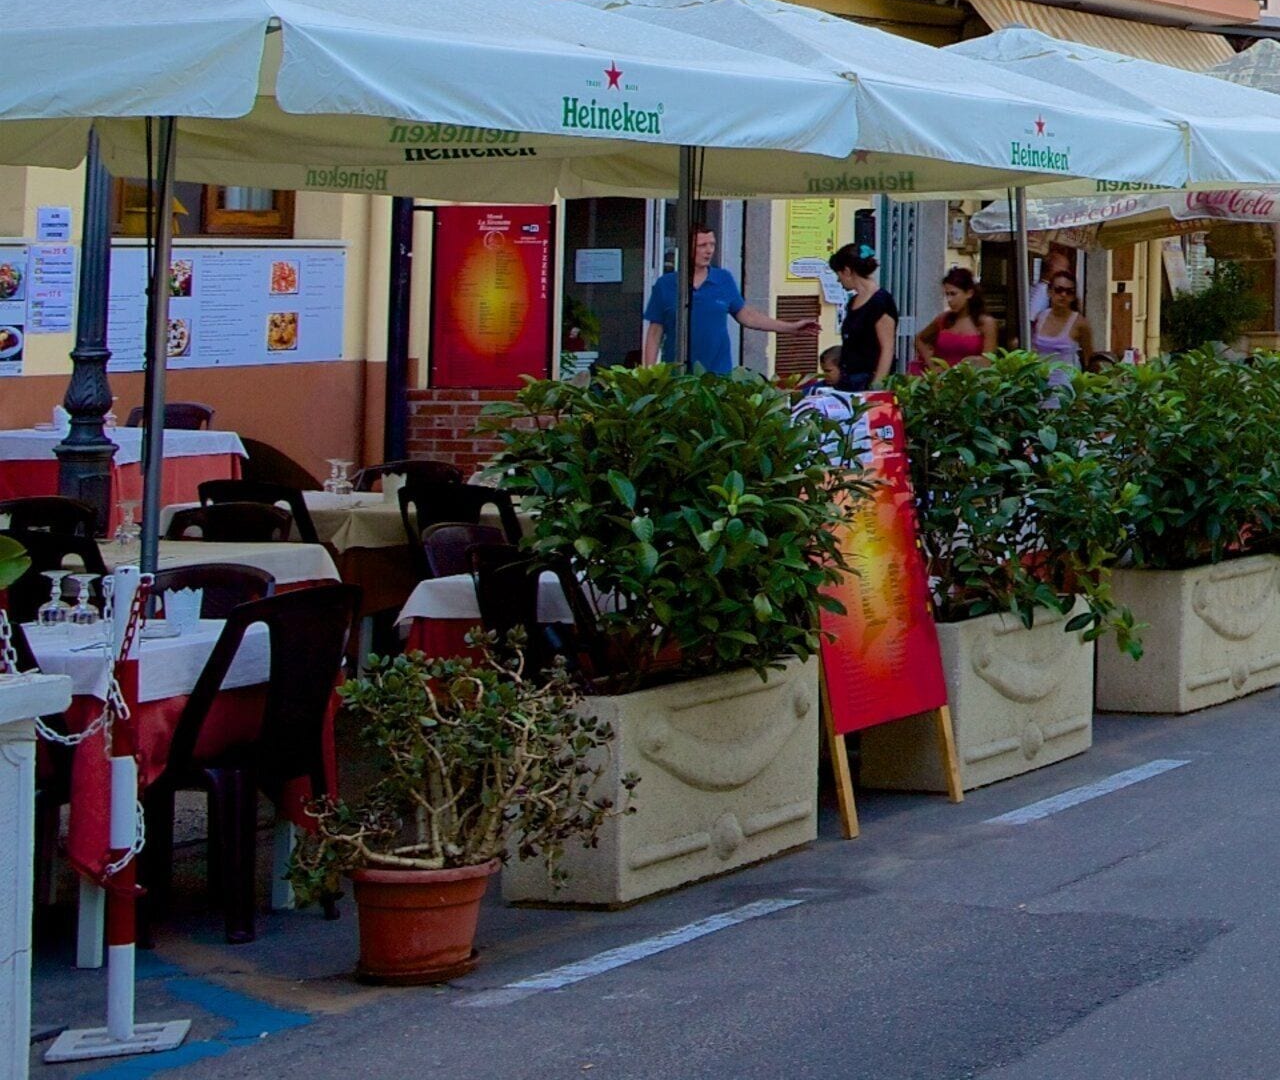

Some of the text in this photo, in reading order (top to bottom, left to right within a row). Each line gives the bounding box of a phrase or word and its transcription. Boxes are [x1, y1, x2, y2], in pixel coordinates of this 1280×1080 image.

[562, 96, 662, 134] Heineken
[1010, 141, 1070, 171] Heineken
[540, 239, 548, 299] PIZZERIA
